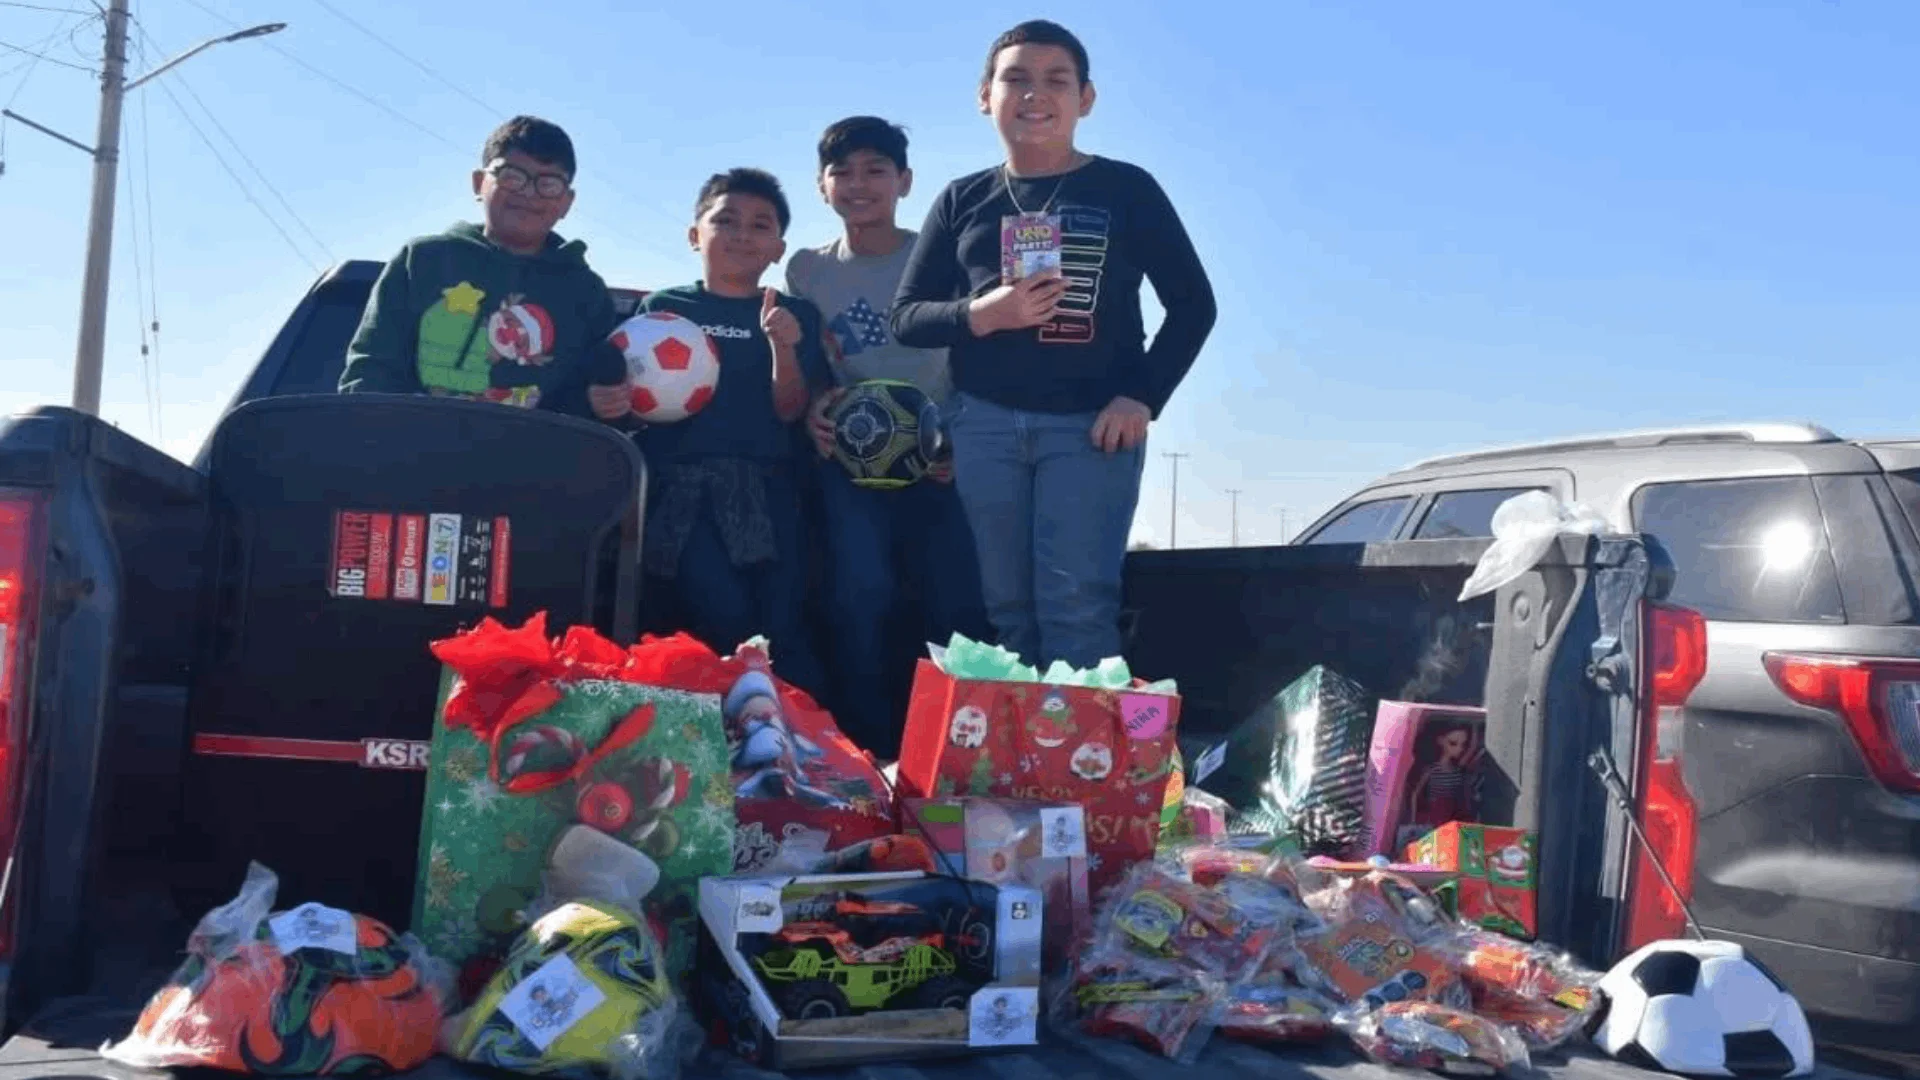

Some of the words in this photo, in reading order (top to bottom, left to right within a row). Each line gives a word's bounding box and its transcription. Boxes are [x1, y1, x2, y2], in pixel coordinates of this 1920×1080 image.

[1015, 225, 1053, 241] UNO
[701, 324, 751, 338] adidas
[337, 568, 365, 597] BIG
[366, 741, 430, 765] KSR
